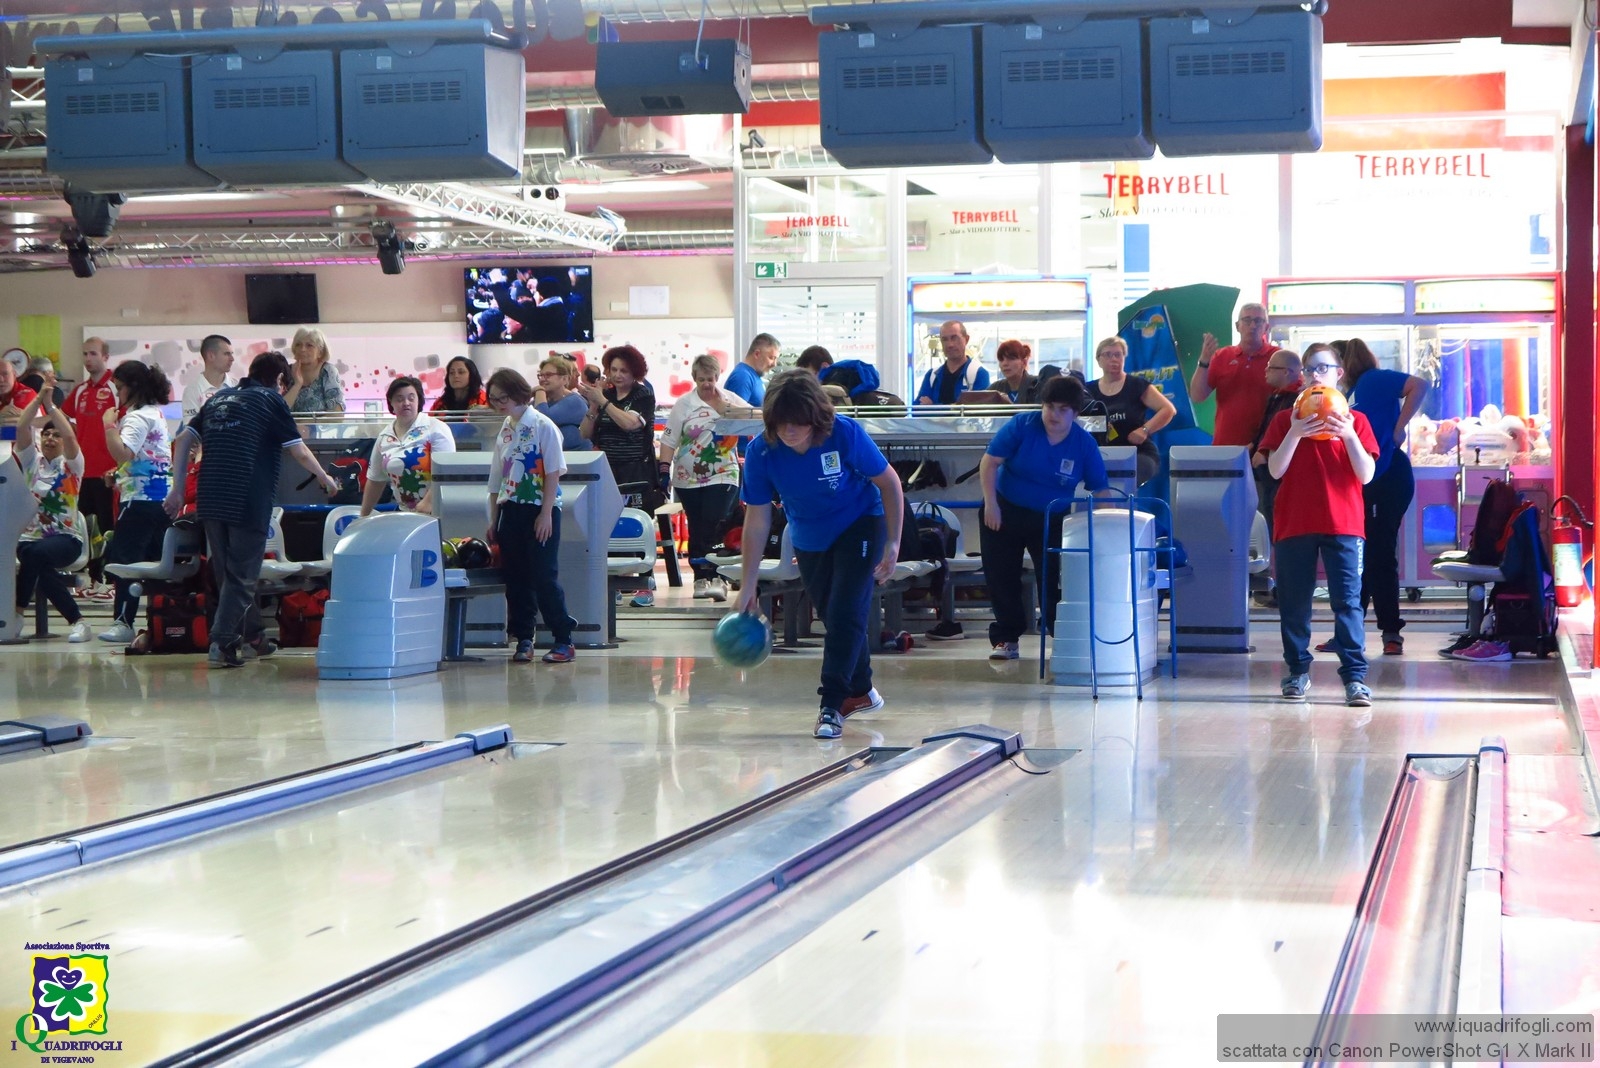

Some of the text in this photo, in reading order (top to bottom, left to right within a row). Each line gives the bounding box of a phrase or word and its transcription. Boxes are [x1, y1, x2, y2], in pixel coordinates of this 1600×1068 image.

[1354, 153, 1491, 179] TERRYBELL
[1103, 173, 1230, 199] TERRYBELL
[952, 209, 1019, 225] TERRYBELL
[1099, 207, 1119, 218] Slot
[786, 215, 850, 228] TERRYBELL
